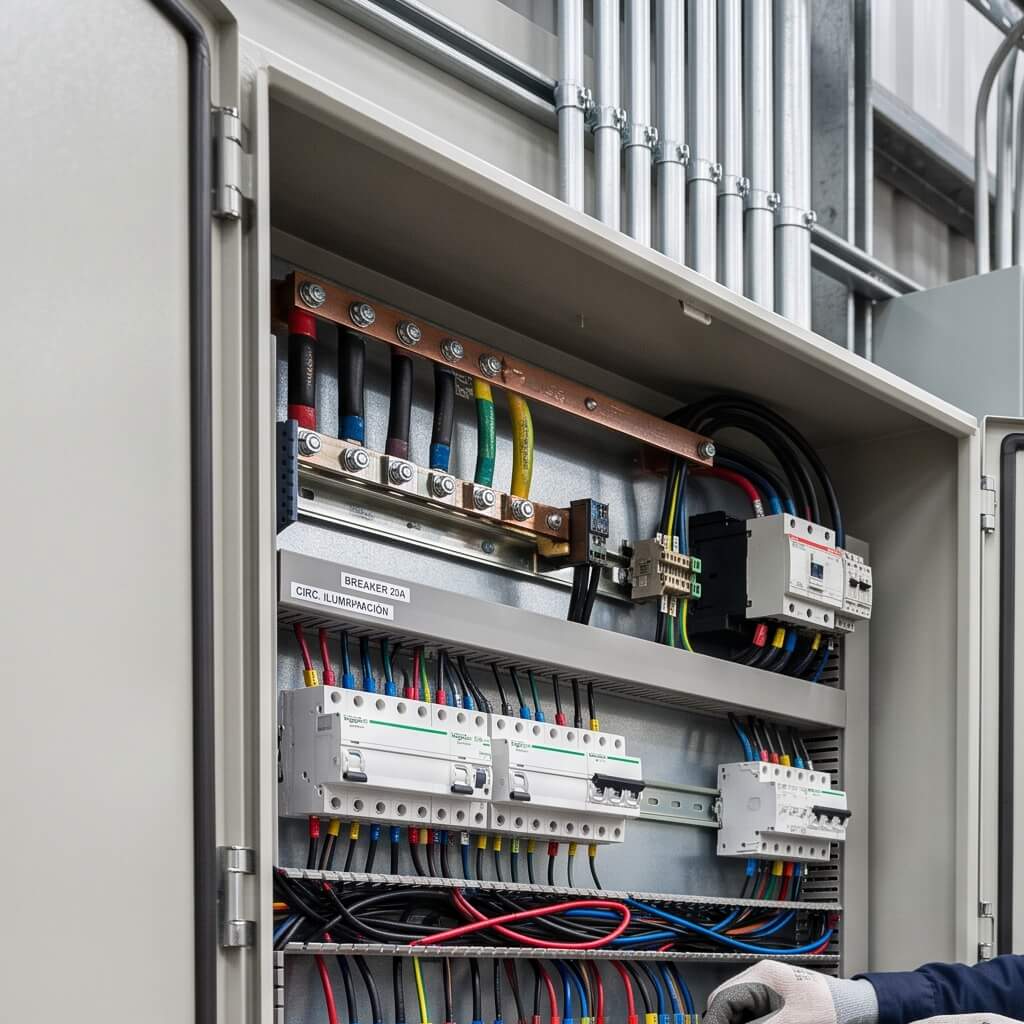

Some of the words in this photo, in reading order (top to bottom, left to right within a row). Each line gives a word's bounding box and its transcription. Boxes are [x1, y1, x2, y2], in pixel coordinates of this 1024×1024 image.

[296, 586, 321, 600] CIRC.
[344, 576, 388, 594] BREAKER
[390, 587, 406, 599] 20A
